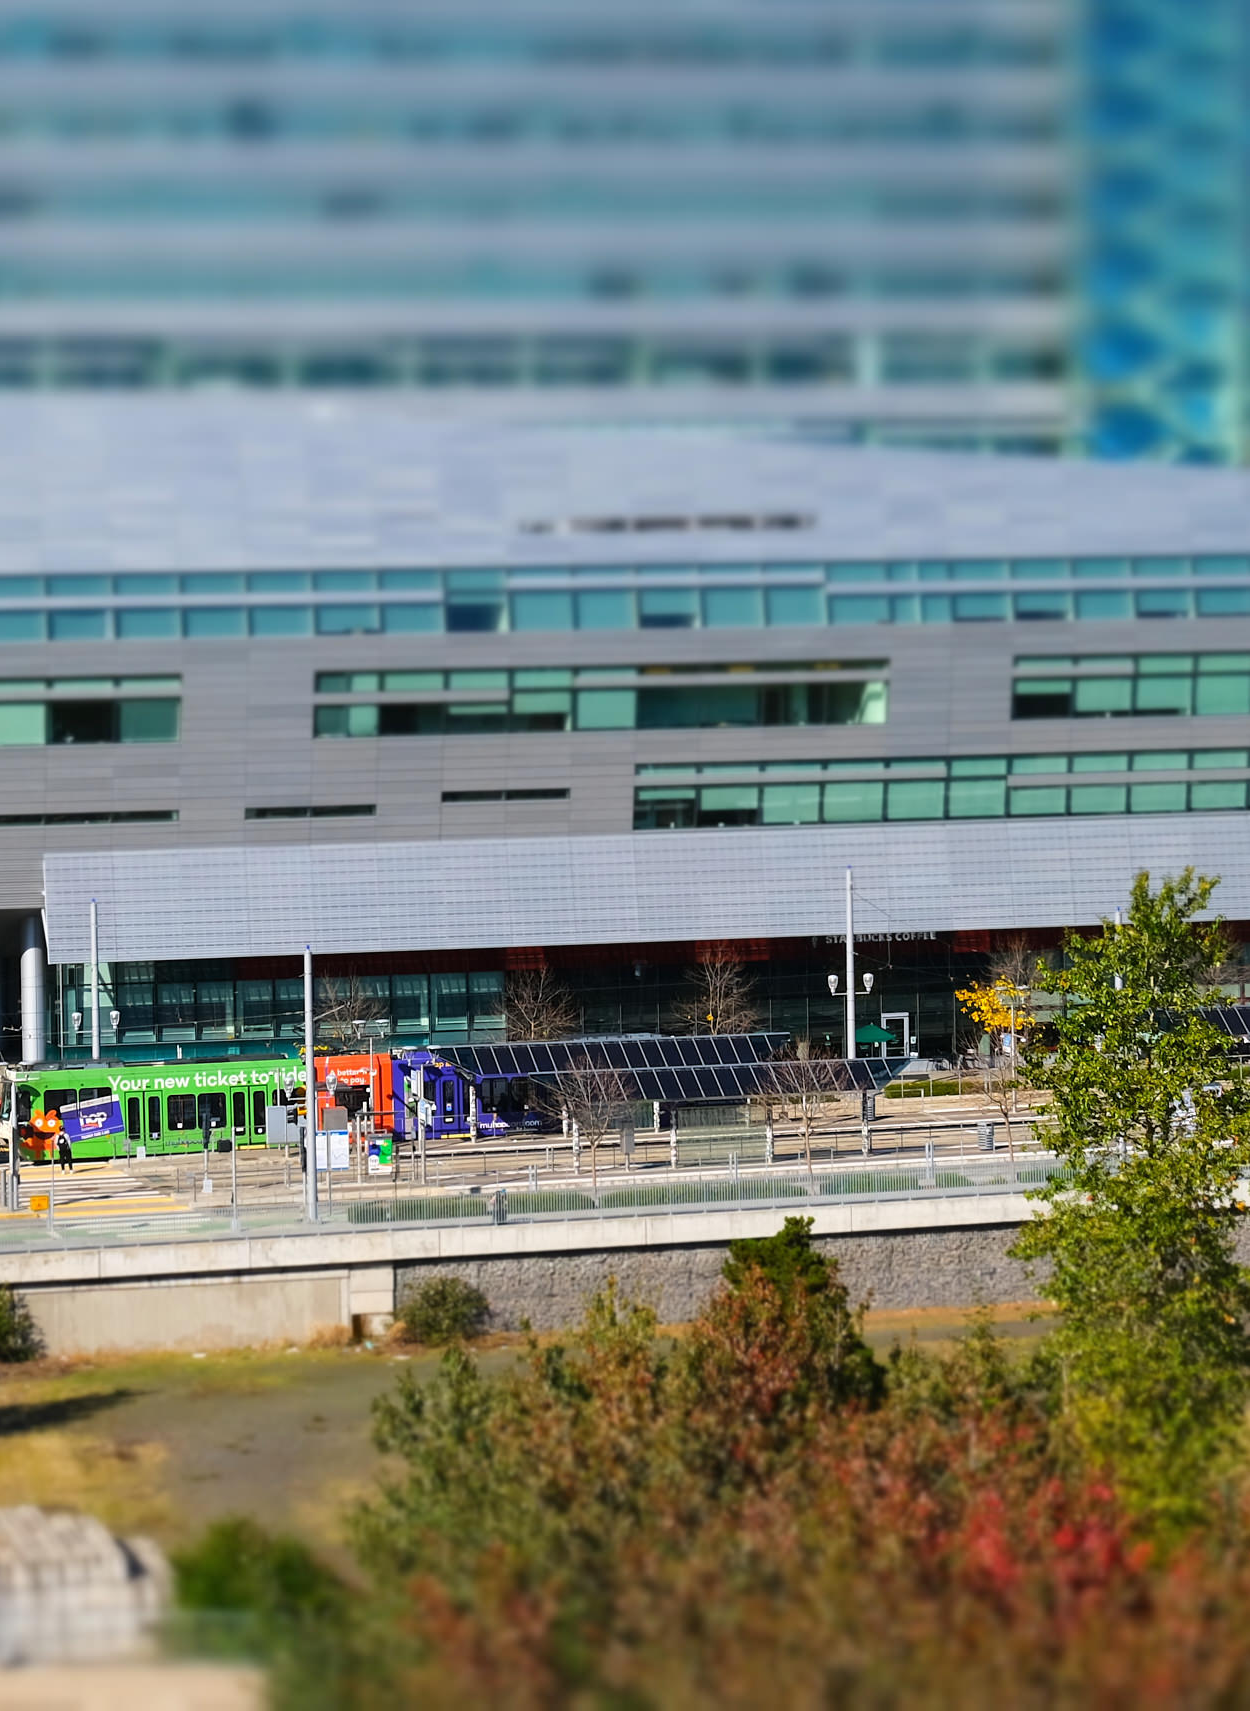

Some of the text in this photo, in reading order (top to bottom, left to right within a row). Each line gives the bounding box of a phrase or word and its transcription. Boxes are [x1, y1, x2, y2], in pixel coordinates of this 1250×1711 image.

[825, 931, 937, 944] STABUCKS COFFEE
[108, 1075, 150, 1092] Your
[154, 1075, 190, 1089] new
[193, 1070, 246, 1087] ticket
[252, 1070, 269, 1085] to
[79, 1111, 108, 1129] hop
